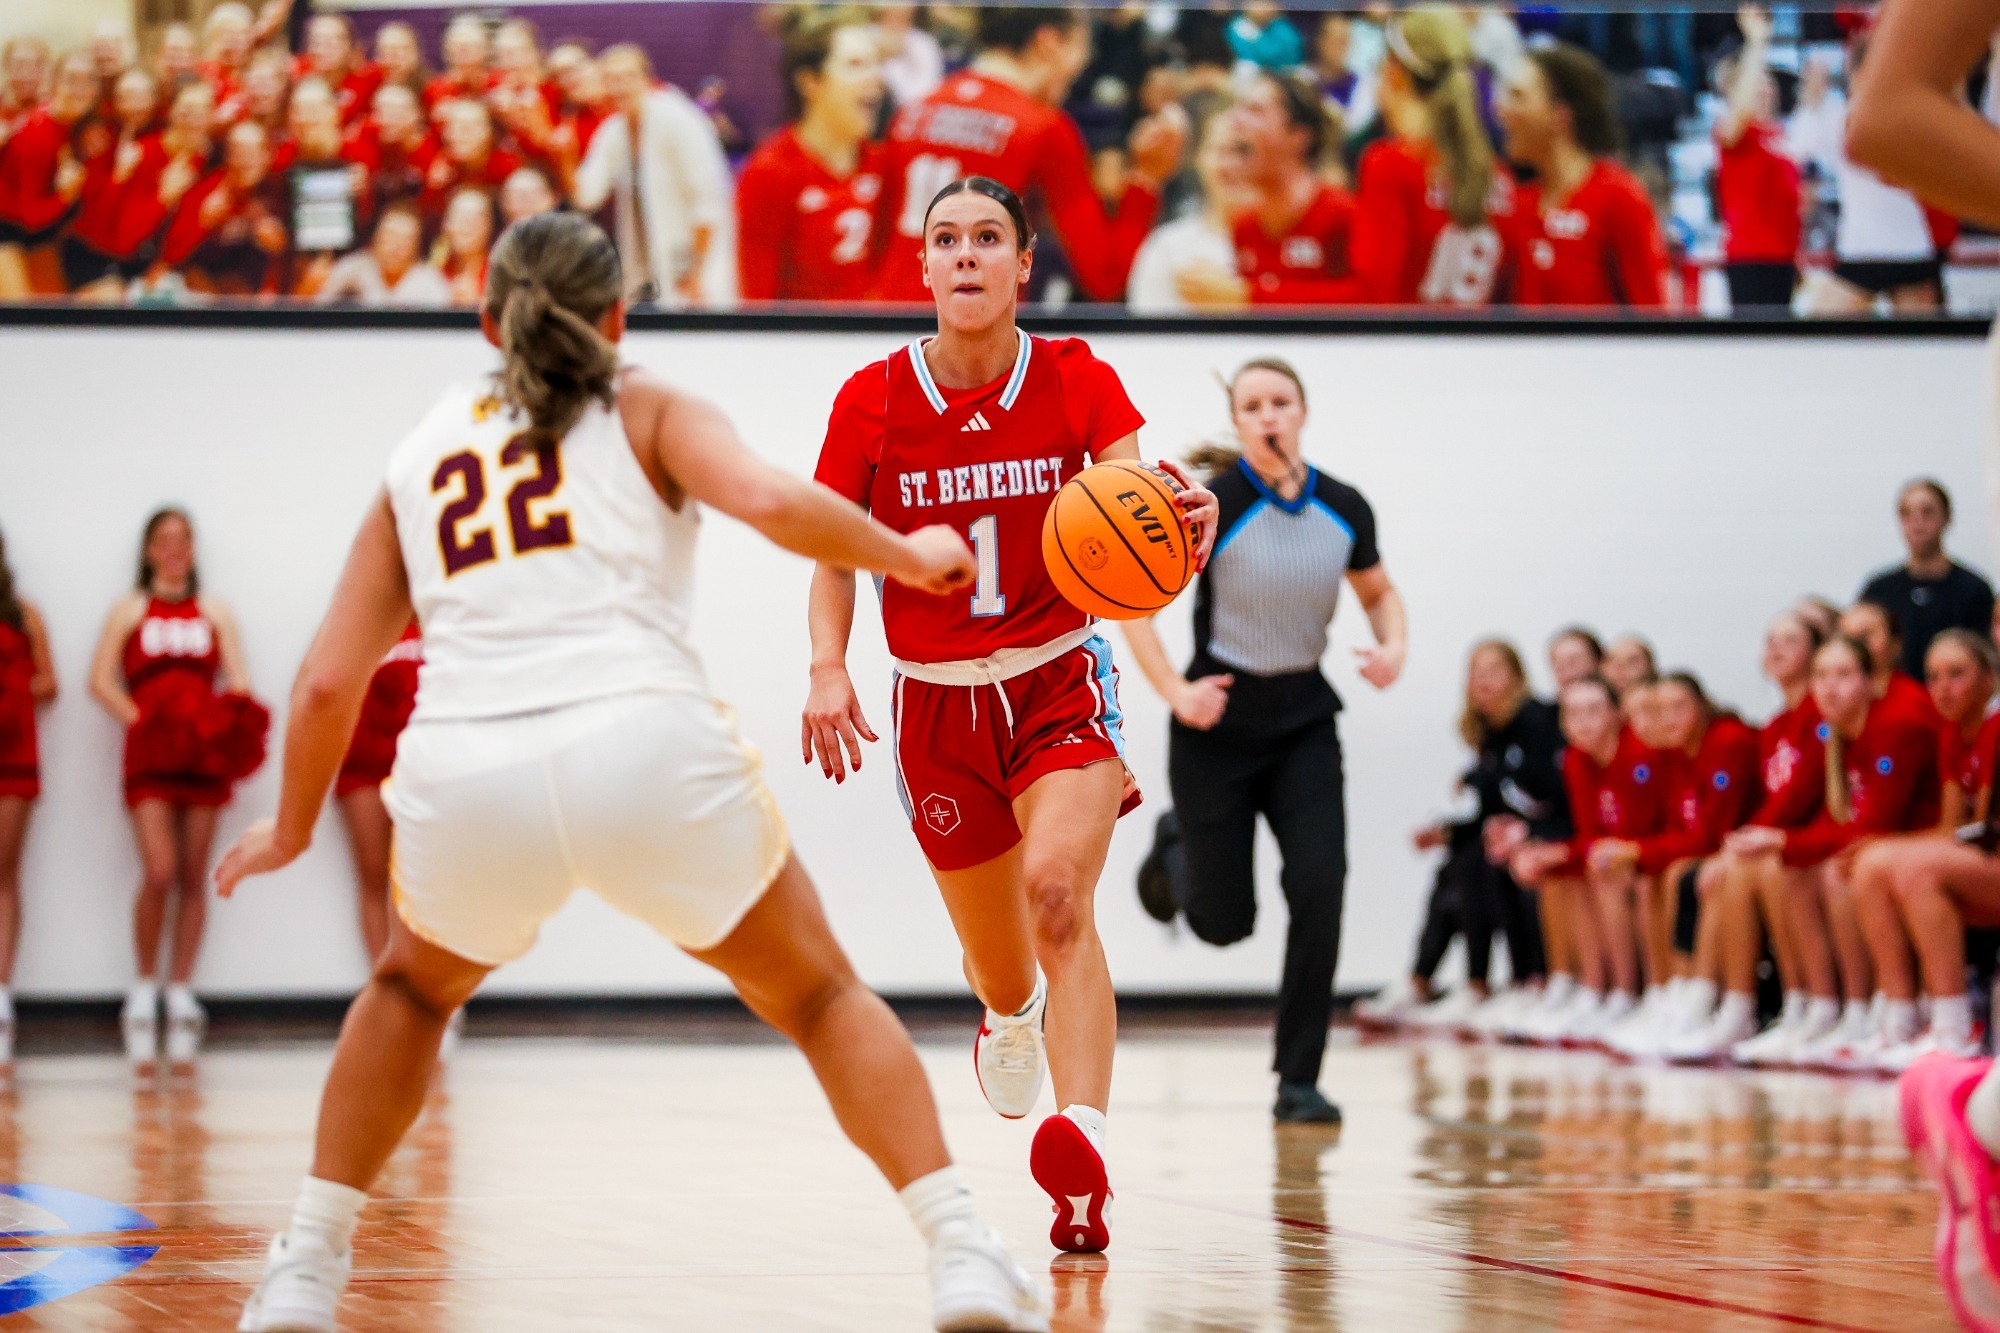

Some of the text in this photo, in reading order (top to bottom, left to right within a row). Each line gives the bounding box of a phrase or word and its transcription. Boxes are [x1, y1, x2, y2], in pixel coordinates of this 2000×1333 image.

[431, 429, 575, 580] 22
[899, 456, 1065, 508] ST. BENEDICT
[1116, 490, 1169, 544] EVO
[1164, 541, 1177, 559] NXT
[968, 514, 1006, 618] 1
